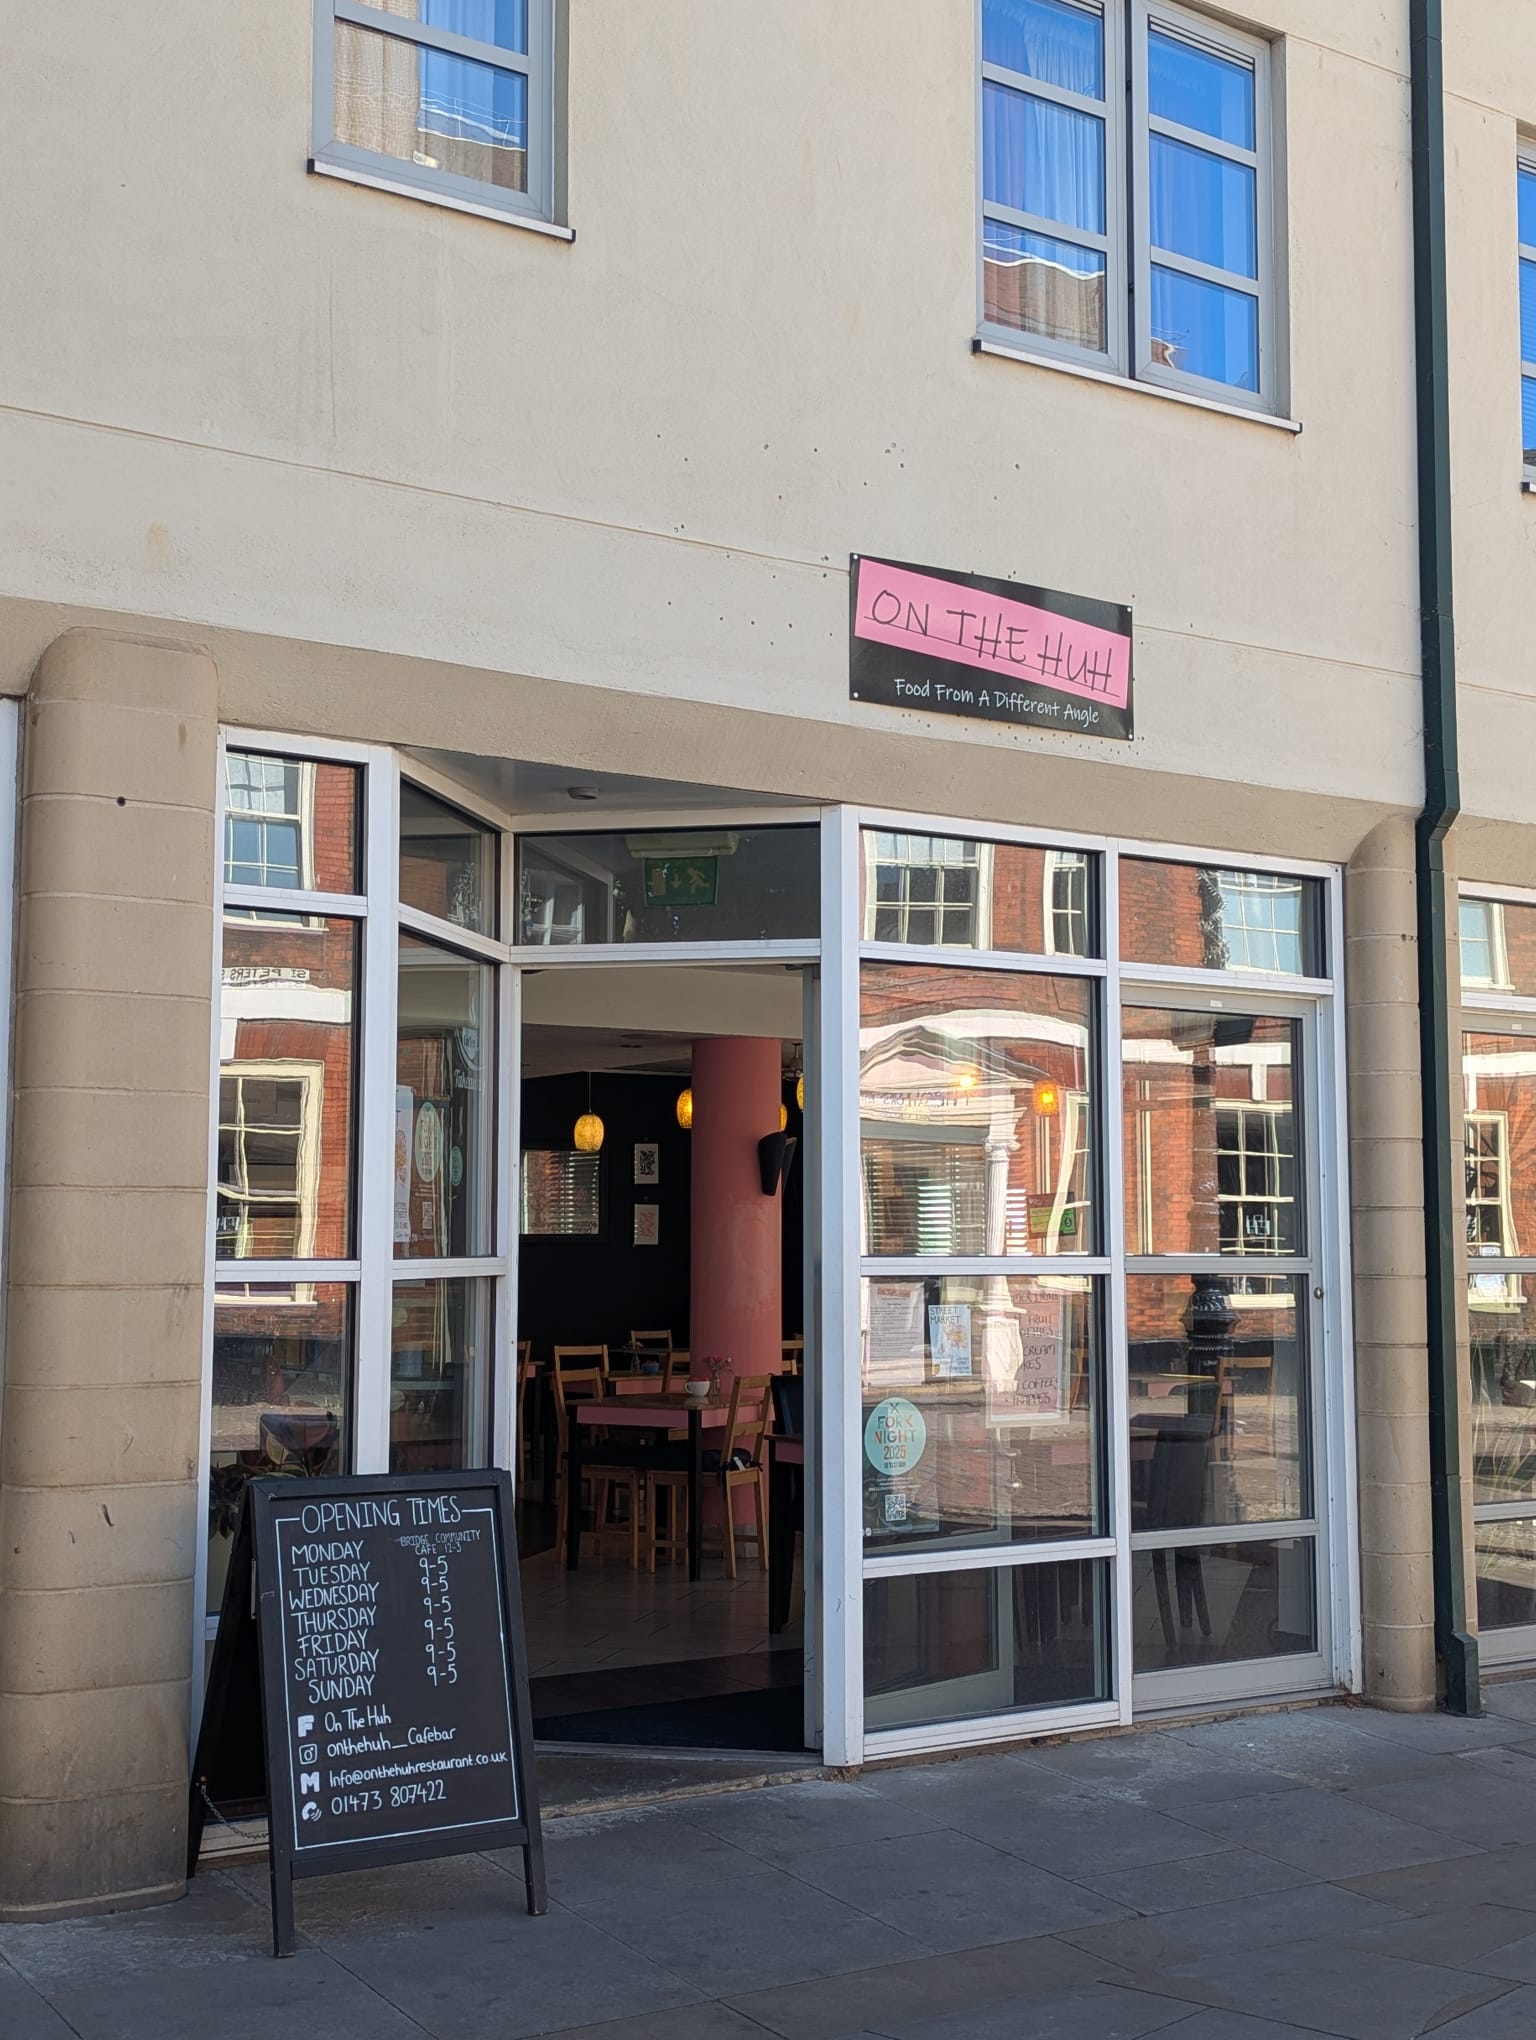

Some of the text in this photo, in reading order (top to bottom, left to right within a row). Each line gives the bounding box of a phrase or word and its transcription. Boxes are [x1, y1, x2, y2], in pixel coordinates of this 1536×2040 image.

[872, 589, 1112, 692] ON THE HUH
[893, 678, 1100, 728] Food From A Different Angle
[929, 1306, 958, 1315] STREET
[930, 1315, 961, 1324] MARKET
[1029, 1313, 1053, 1325] FRUIT
[1023, 1344, 1055, 1356] CREAM
[874, 1429, 916, 1444] NIGHT
[877, 1415, 912, 1429] FORK
[883, 1446, 906, 1460] 2025
[301, 1495, 461, 1534] OPENING TIMES
[291, 1540, 364, 1565] MONDAY
[400, 1528, 481, 1547] BRIDGE COMMUNITY
[415, 1543, 437, 1555] CAFE
[292, 1555, 448, 1587] TUESDAY 9-5
[288, 1575, 449, 1610] WEDNESDAY 9-5
[290, 1596, 452, 1635] THURSDAY 9-5
[297, 1617, 455, 1657] FRIDAY 9-5
[294, 1641, 456, 1681] SATURDAY 9-5
[308, 1663, 458, 1704] SUNDAY 9-5
[324, 1712, 343, 1733] On
[341, 1707, 365, 1731] The
[367, 1704, 392, 1725] Huh
[330, 1751, 508, 1789] Info@onthehuhrestaurant.co.uk
[331, 1779, 447, 1815] 01473 807422
